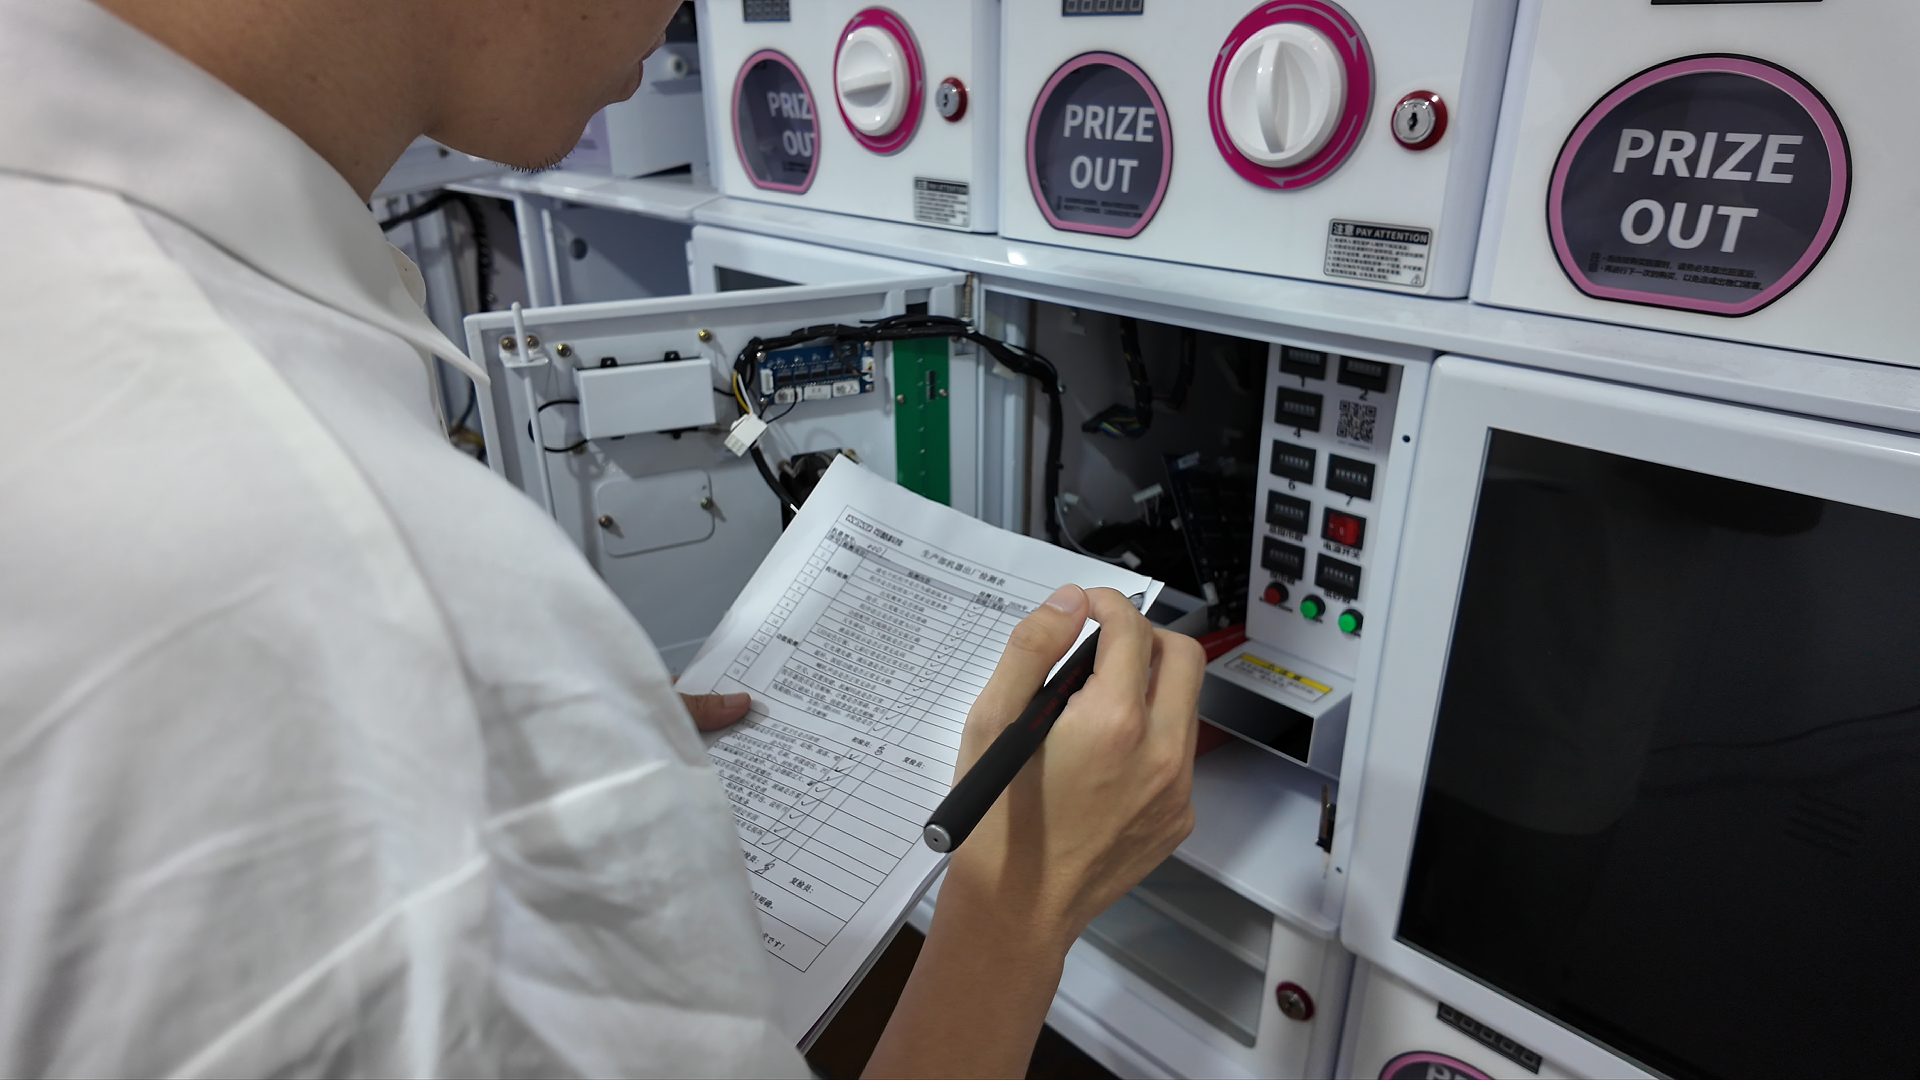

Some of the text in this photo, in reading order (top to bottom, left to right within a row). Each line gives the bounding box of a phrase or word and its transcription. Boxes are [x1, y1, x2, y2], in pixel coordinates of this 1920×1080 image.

[1063, 104, 1156, 143] PRIZE
[1612, 128, 1804, 184] PRIZE
[1070, 155, 1139, 193] OUT
[1356, 227, 1373, 238] PAY
[1374, 229, 1428, 244] ATTENTION
[1620, 199, 1759, 253] OUT
[1293, 427, 1301, 439] 4
[1288, 479, 1296, 490] 6
[922, 549, 1006, 587] 生产部机器出厂检测表
[902, 756, 926, 770] 复检员：
[788, 876, 815, 894] 复检员：
